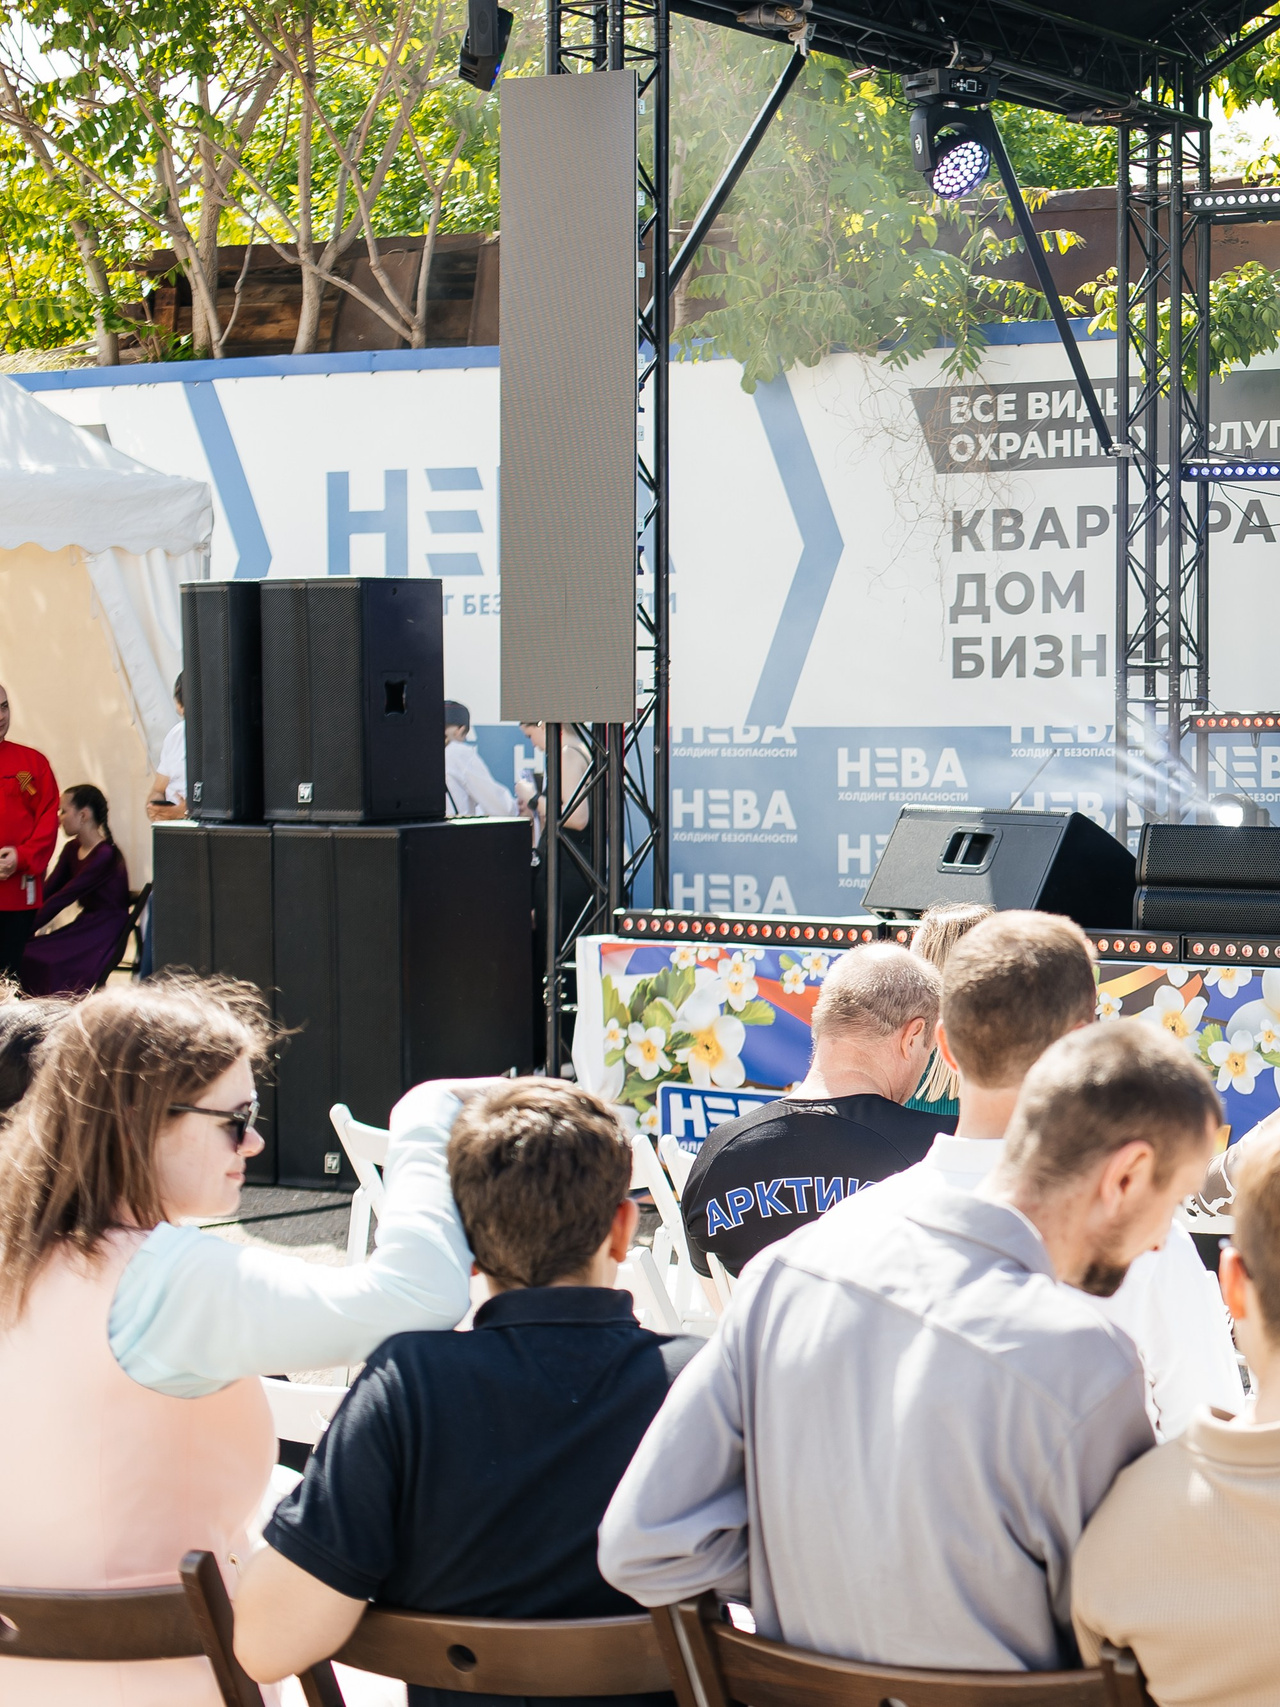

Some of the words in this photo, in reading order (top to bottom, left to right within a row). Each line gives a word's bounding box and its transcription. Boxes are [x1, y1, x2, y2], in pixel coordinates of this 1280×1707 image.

[950, 393, 1018, 424] ВСЕ
[949, 426, 1148, 463] ОХРАННХ
[950, 570, 1085, 624] ДОМ
[672, 747, 719, 758] ХОЛДИНГ
[721, 748, 797, 758] БЕЗОПАСНОСТИ
[837, 747, 968, 788] НЕВА
[672, 789, 797, 830] НЕВА
[838, 792, 887, 803] ХОЛДИНГ
[889, 792, 968, 802] БЕЗОПАСНОСТИ
[673, 832, 719, 843] ХОЛДИНГ
[721, 833, 797, 843] БЕЗОПАСНОСТИ
[672, 873, 798, 914] НЕВА
[669, 1093, 765, 1138] НЕ
